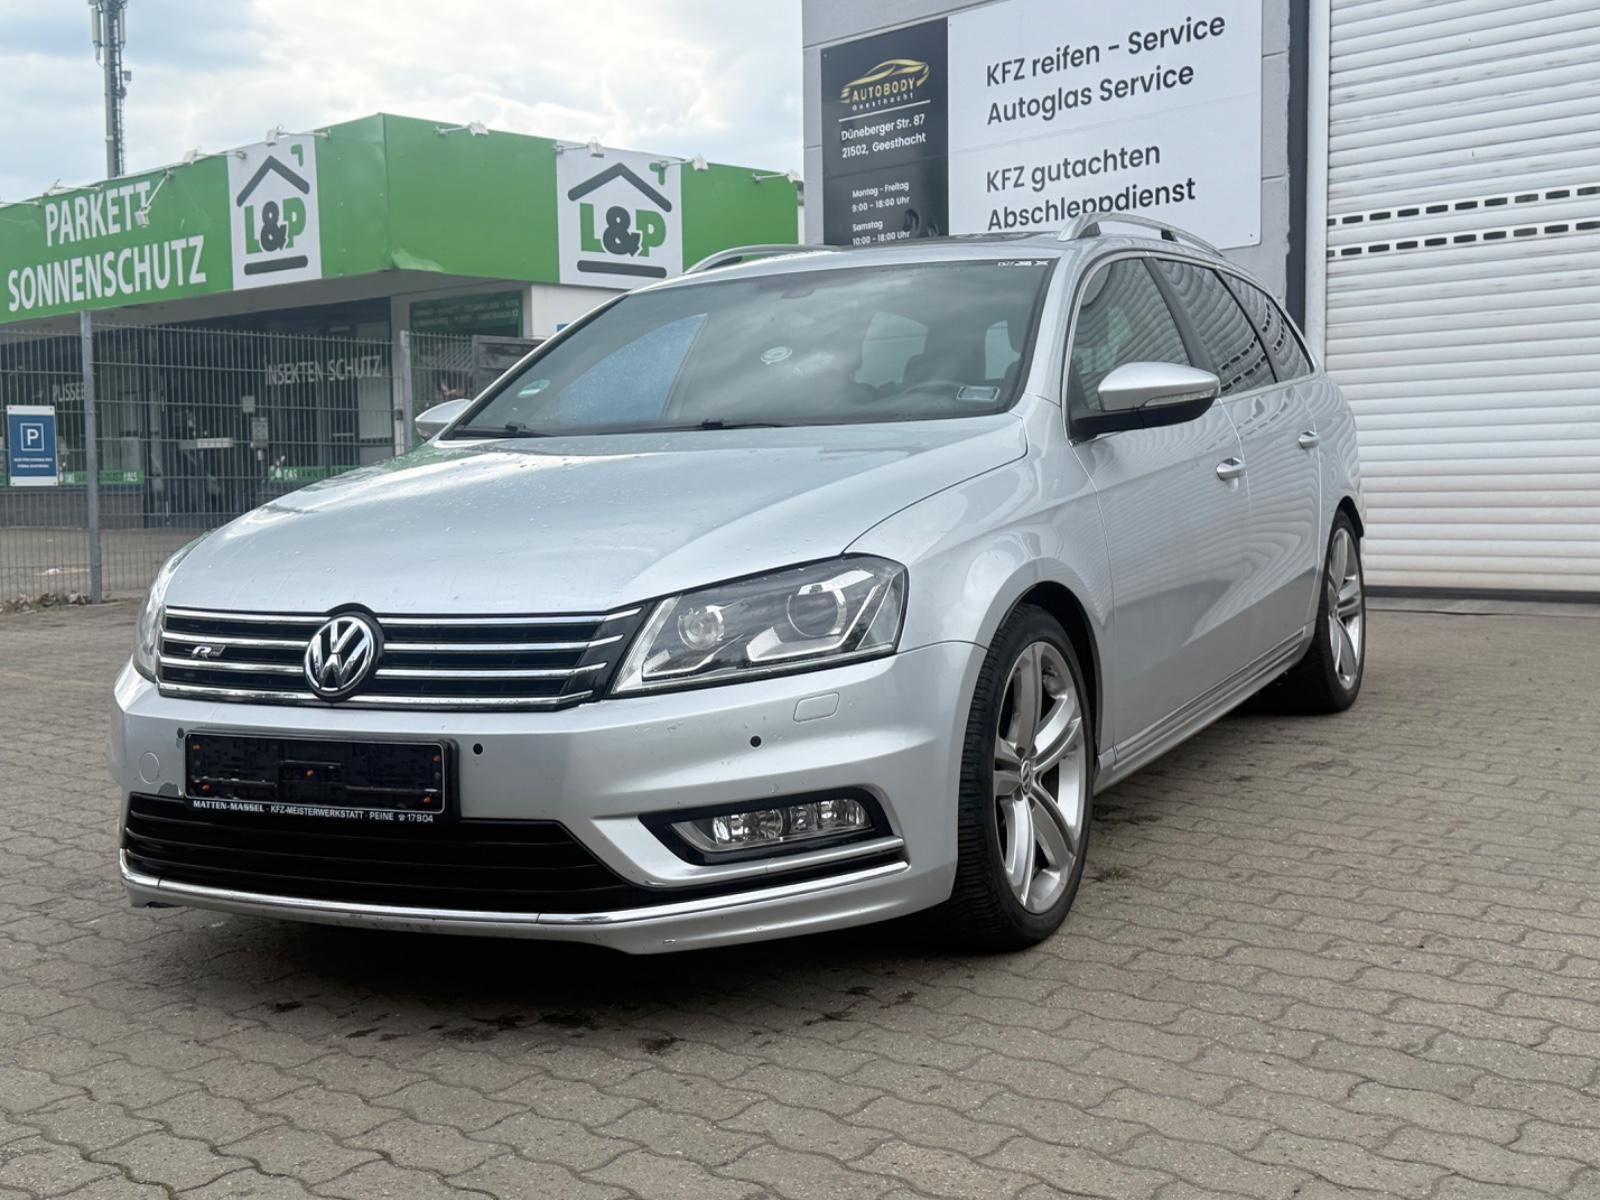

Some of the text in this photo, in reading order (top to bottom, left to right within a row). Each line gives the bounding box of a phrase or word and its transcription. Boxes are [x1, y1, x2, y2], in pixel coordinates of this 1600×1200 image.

[986, 57, 1025, 87] KFZ
[1032, 44, 1100, 77] reifen
[1128, 16, 1226, 55] Service
[852, 77, 915, 102] AUTOBODY
[987, 64, 1194, 125] Autoglas Service
[841, 113, 925, 141] Düneberger Str. 87
[842, 132, 927, 158] 21502, Geesthacht
[986, 145, 1161, 193] KFZ gutachten
[852, 187, 879, 198] Montag
[884, 182, 910, 193] Freitag
[896, 196, 911, 205] Uhr
[987, 177, 1196, 231] Abschleppdienst
[45, 181, 151, 247] PARKETT
[244, 197, 307, 255] L&P
[852, 220, 884, 232] Samstag
[579, 202, 667, 257] L&P
[897, 230, 911, 240] Uhr
[8, 235, 207, 312] SONNENSCHUTZ
[265, 355, 382, 385] INSEKTEN SCHUTZ
[26, 428, 40, 447] P
[270, 805, 364, 819] KFZ-MEISTERWERKSTATT
[369, 811, 394, 821] PEINE
